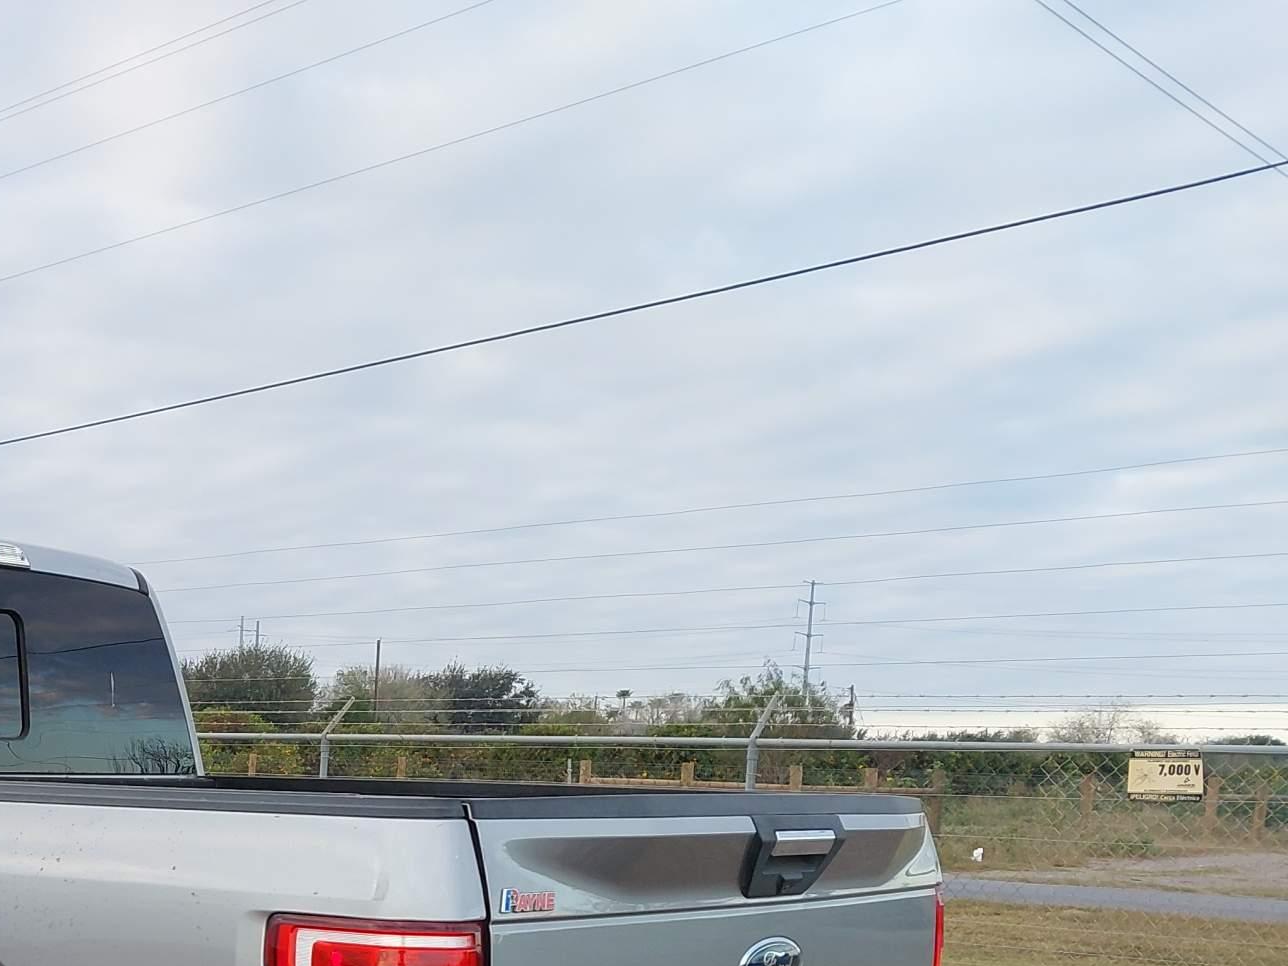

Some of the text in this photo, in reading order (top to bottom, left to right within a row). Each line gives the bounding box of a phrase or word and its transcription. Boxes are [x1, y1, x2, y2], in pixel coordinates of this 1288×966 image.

[1158, 764, 1200, 776] 7,000 V
[501, 888, 556, 912] PAYNE
